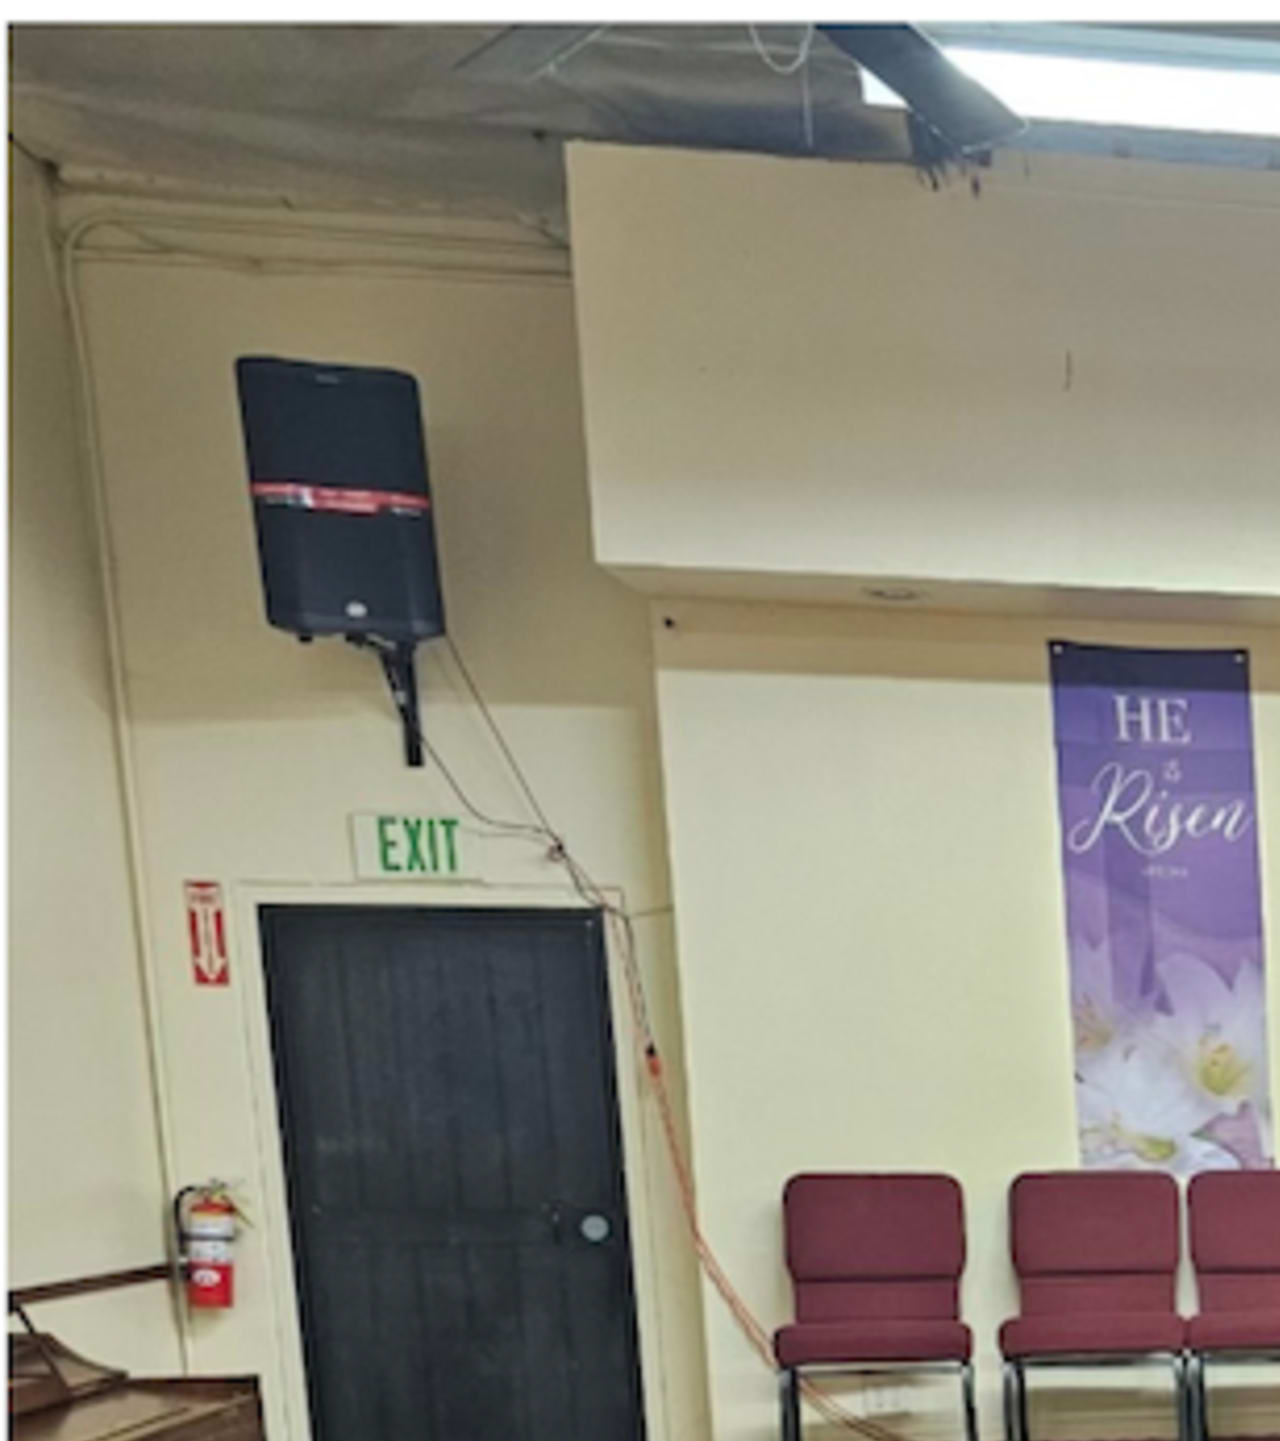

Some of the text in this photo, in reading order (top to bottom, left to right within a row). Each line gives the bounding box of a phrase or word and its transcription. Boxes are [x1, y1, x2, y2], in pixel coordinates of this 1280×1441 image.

[1114, 694, 1192, 743] HE
[1068, 760, 1253, 857] Risen
[377, 817, 459, 872] EXIT
